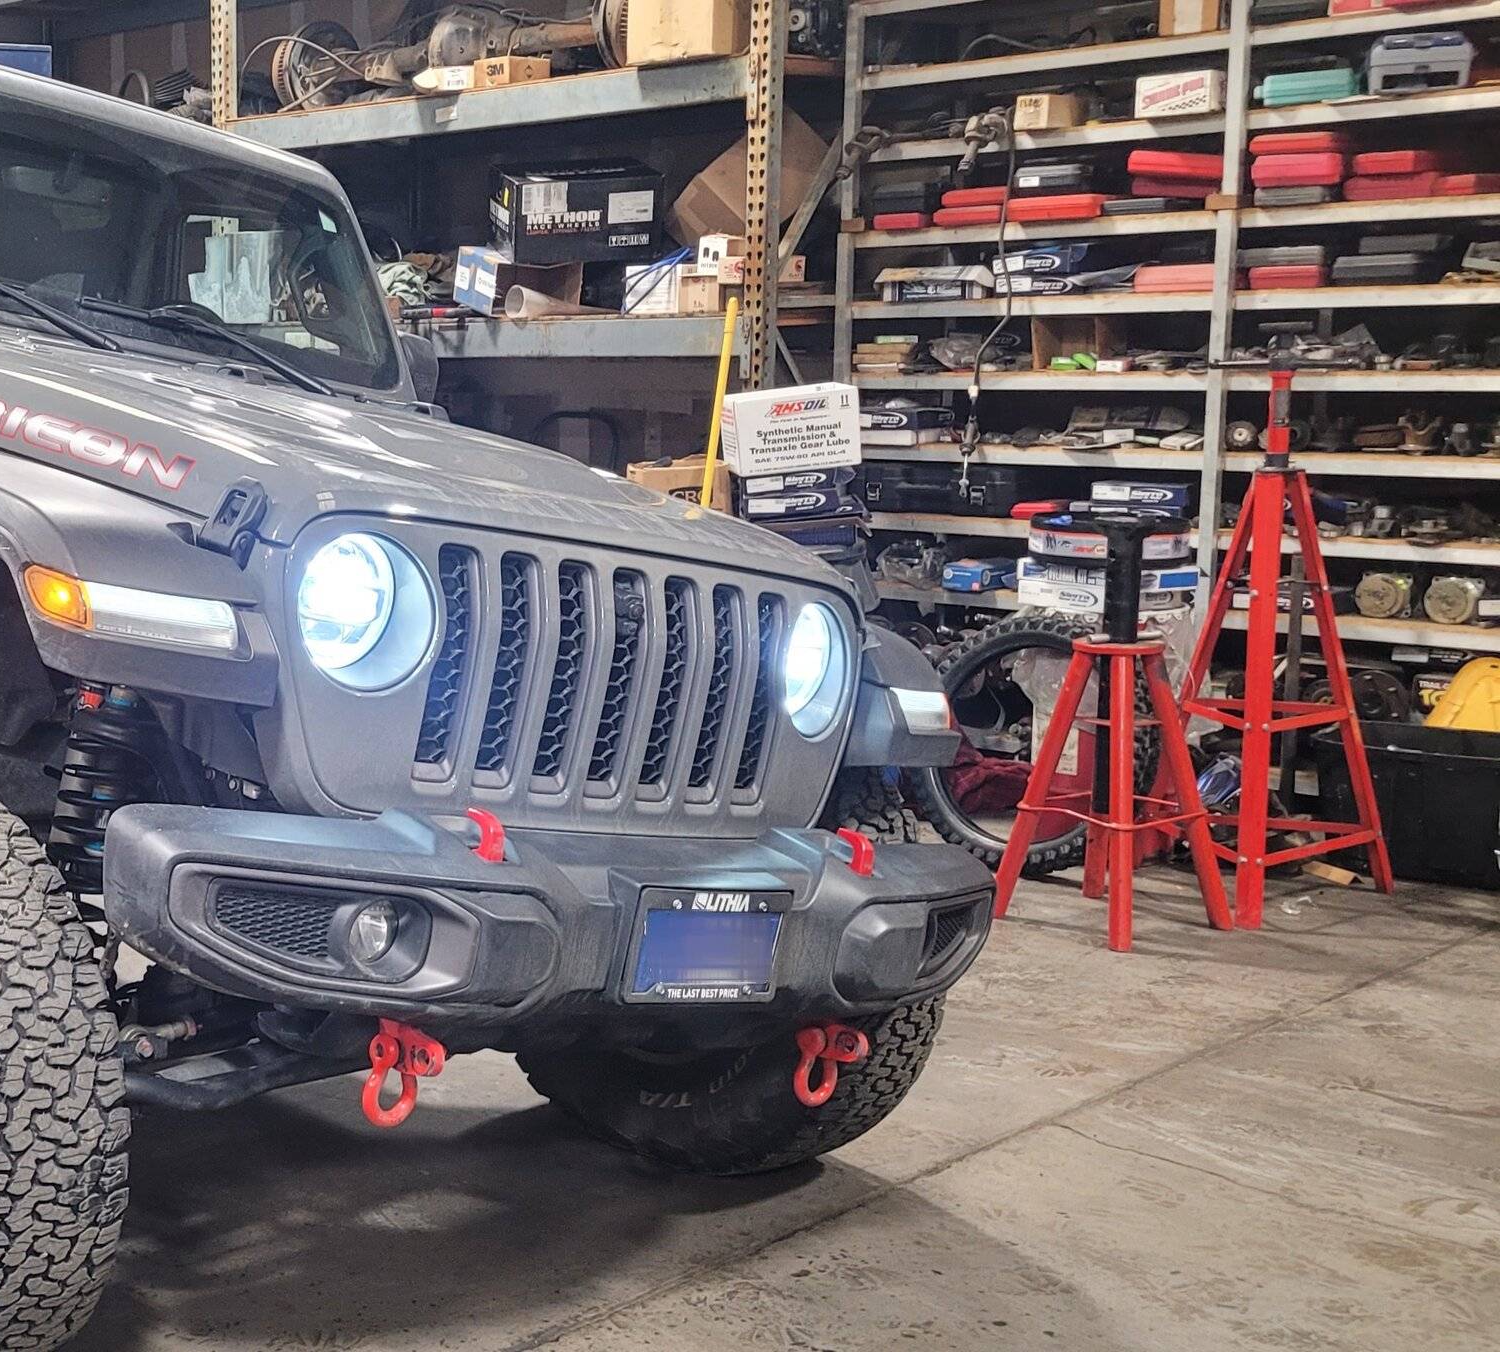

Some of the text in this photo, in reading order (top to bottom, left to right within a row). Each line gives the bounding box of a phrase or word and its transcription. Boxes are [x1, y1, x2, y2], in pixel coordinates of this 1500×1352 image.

[486, 63, 505, 77] 3M
[527, 210, 601, 225] METHOD
[768, 398, 828, 417] AMSOIL
[756, 421, 842, 438] Synthetic Manual
[749, 437, 851, 456] Transaxle Gear Lube
[762, 432, 826, 446] Transmission
[705, 893, 751, 913] LITHIA
[667, 988, 739, 999] THE LAST BEST PRICE
